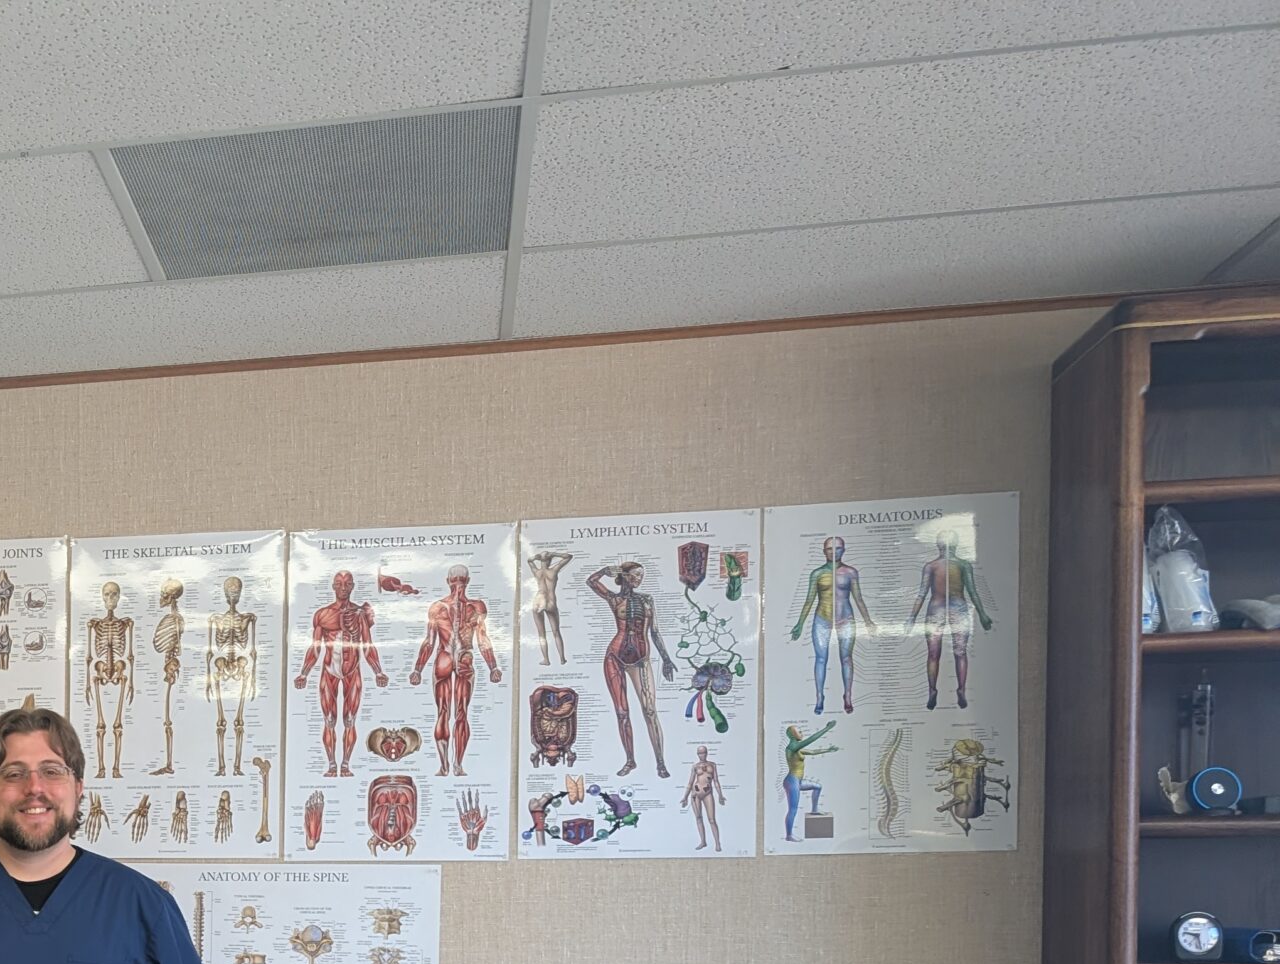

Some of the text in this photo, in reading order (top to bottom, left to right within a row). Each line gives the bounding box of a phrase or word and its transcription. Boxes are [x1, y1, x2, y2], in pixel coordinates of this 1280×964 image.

[838, 508, 943, 525] DERMATOMES
[570, 522, 709, 539] LYMPHATIC SYSTEM
[319, 534, 485, 550] THE MUSCULAR SYSTEM
[2, 548, 43, 559] JOINTS
[102, 544, 252, 559] THE SKELETAL SYSTEM
[198, 872, 349, 883] ANATOMY OF THE SPINE
